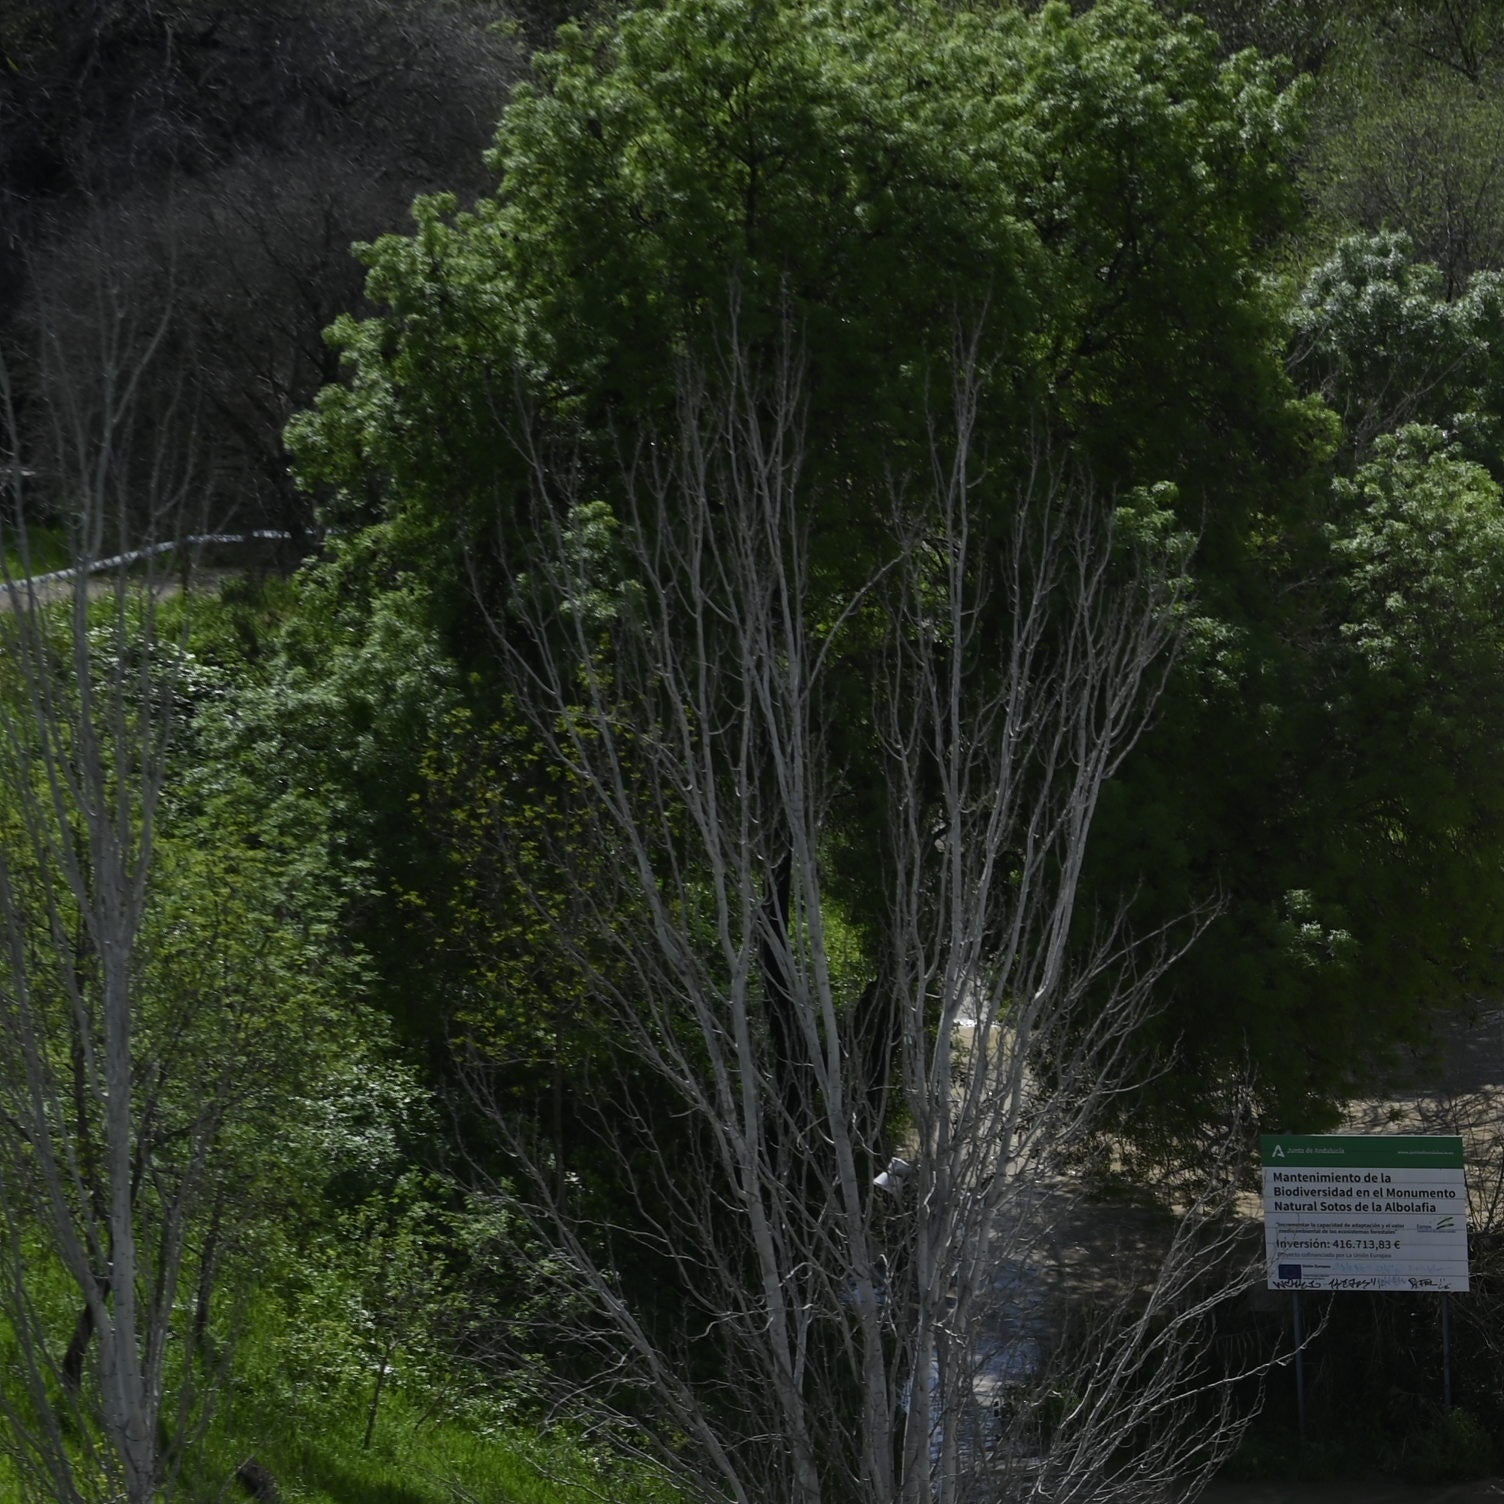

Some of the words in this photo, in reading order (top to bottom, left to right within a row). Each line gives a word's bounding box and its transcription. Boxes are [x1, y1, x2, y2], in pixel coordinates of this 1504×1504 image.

[1273, 1172, 1361, 1183] Mantenimiento
[1363, 1173, 1378, 1183] de
[1380, 1173, 1391, 1183] la
[1274, 1187, 1353, 1197] Biodiversidad
[1356, 1189, 1370, 1197] en
[1373, 1187, 1384, 1198] el
[1386, 1188, 1456, 1199] Monumento
[1275, 1201, 1317, 1212] Natural
[1321, 1202, 1351, 1212] Sotos
[1354, 1202, 1369, 1212] de
[1371, 1202, 1382, 1212] la
[1384, 1202, 1437, 1213] Albolafia
[1276, 1238, 1331, 1249] Inversión:
[1333, 1240, 1391, 1251] 416.713,83
[1394, 1240, 1401, 1249] €
